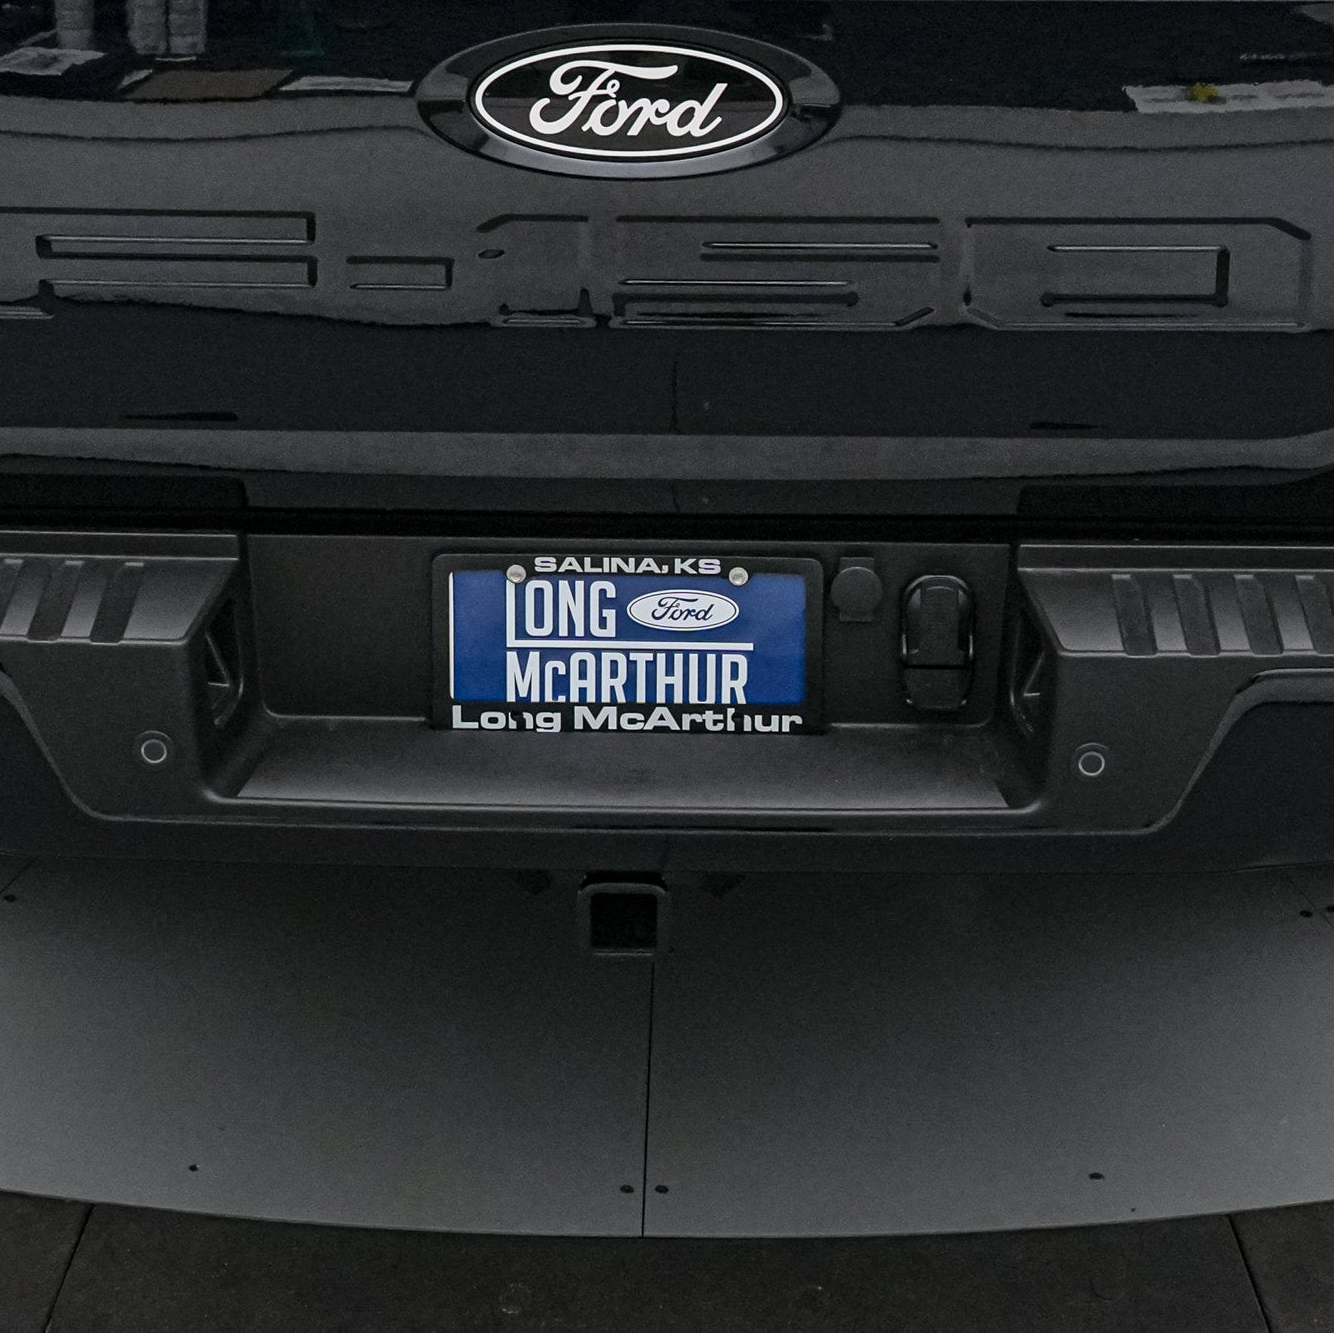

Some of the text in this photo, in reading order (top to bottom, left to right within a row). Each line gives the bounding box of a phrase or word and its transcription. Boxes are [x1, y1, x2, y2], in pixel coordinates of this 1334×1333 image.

[529, 60, 728, 138] Ford
[674, 557, 721, 575] KS
[505, 578, 616, 642] LONG
[650, 597, 714, 623] Ford
[506, 651, 749, 705] McARTHUR
[452, 705, 803, 733] Long McArthur
